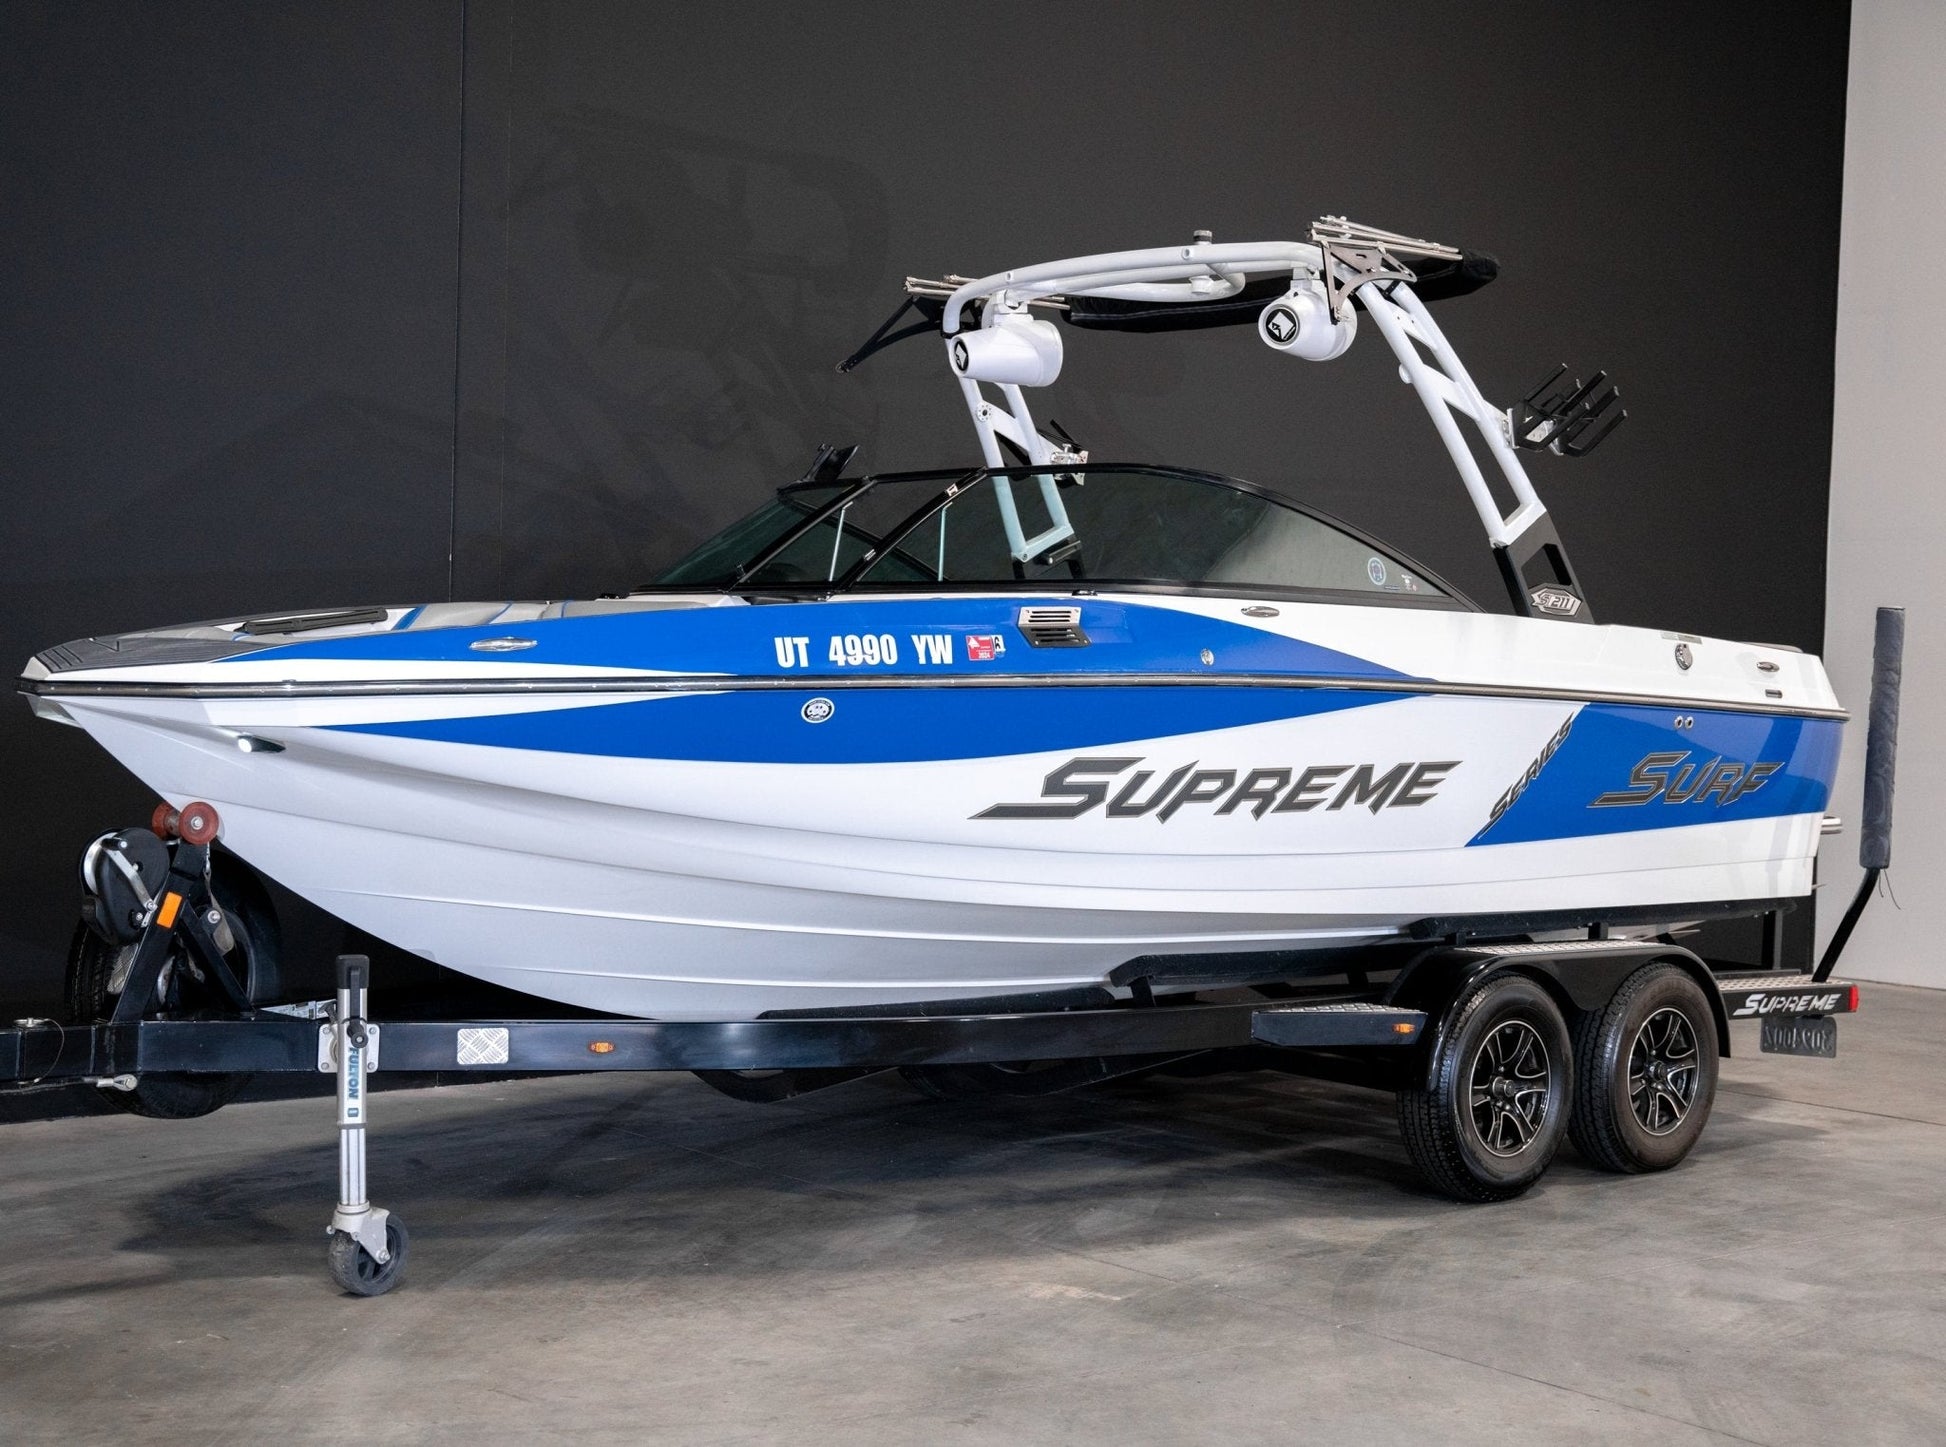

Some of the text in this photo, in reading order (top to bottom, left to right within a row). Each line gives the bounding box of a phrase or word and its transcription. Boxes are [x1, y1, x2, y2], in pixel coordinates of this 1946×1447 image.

[774, 636, 810, 668] UT
[829, 634, 898, 667] 4990
[911, 634, 953, 665] YW
[967, 756, 1464, 824] SUPREME
[1477, 711, 1575, 840] SERIES
[1587, 751, 1786, 808] SURF
[1733, 993, 1842, 1016] SUPREME
[348, 1047, 360, 1100] FULTON
